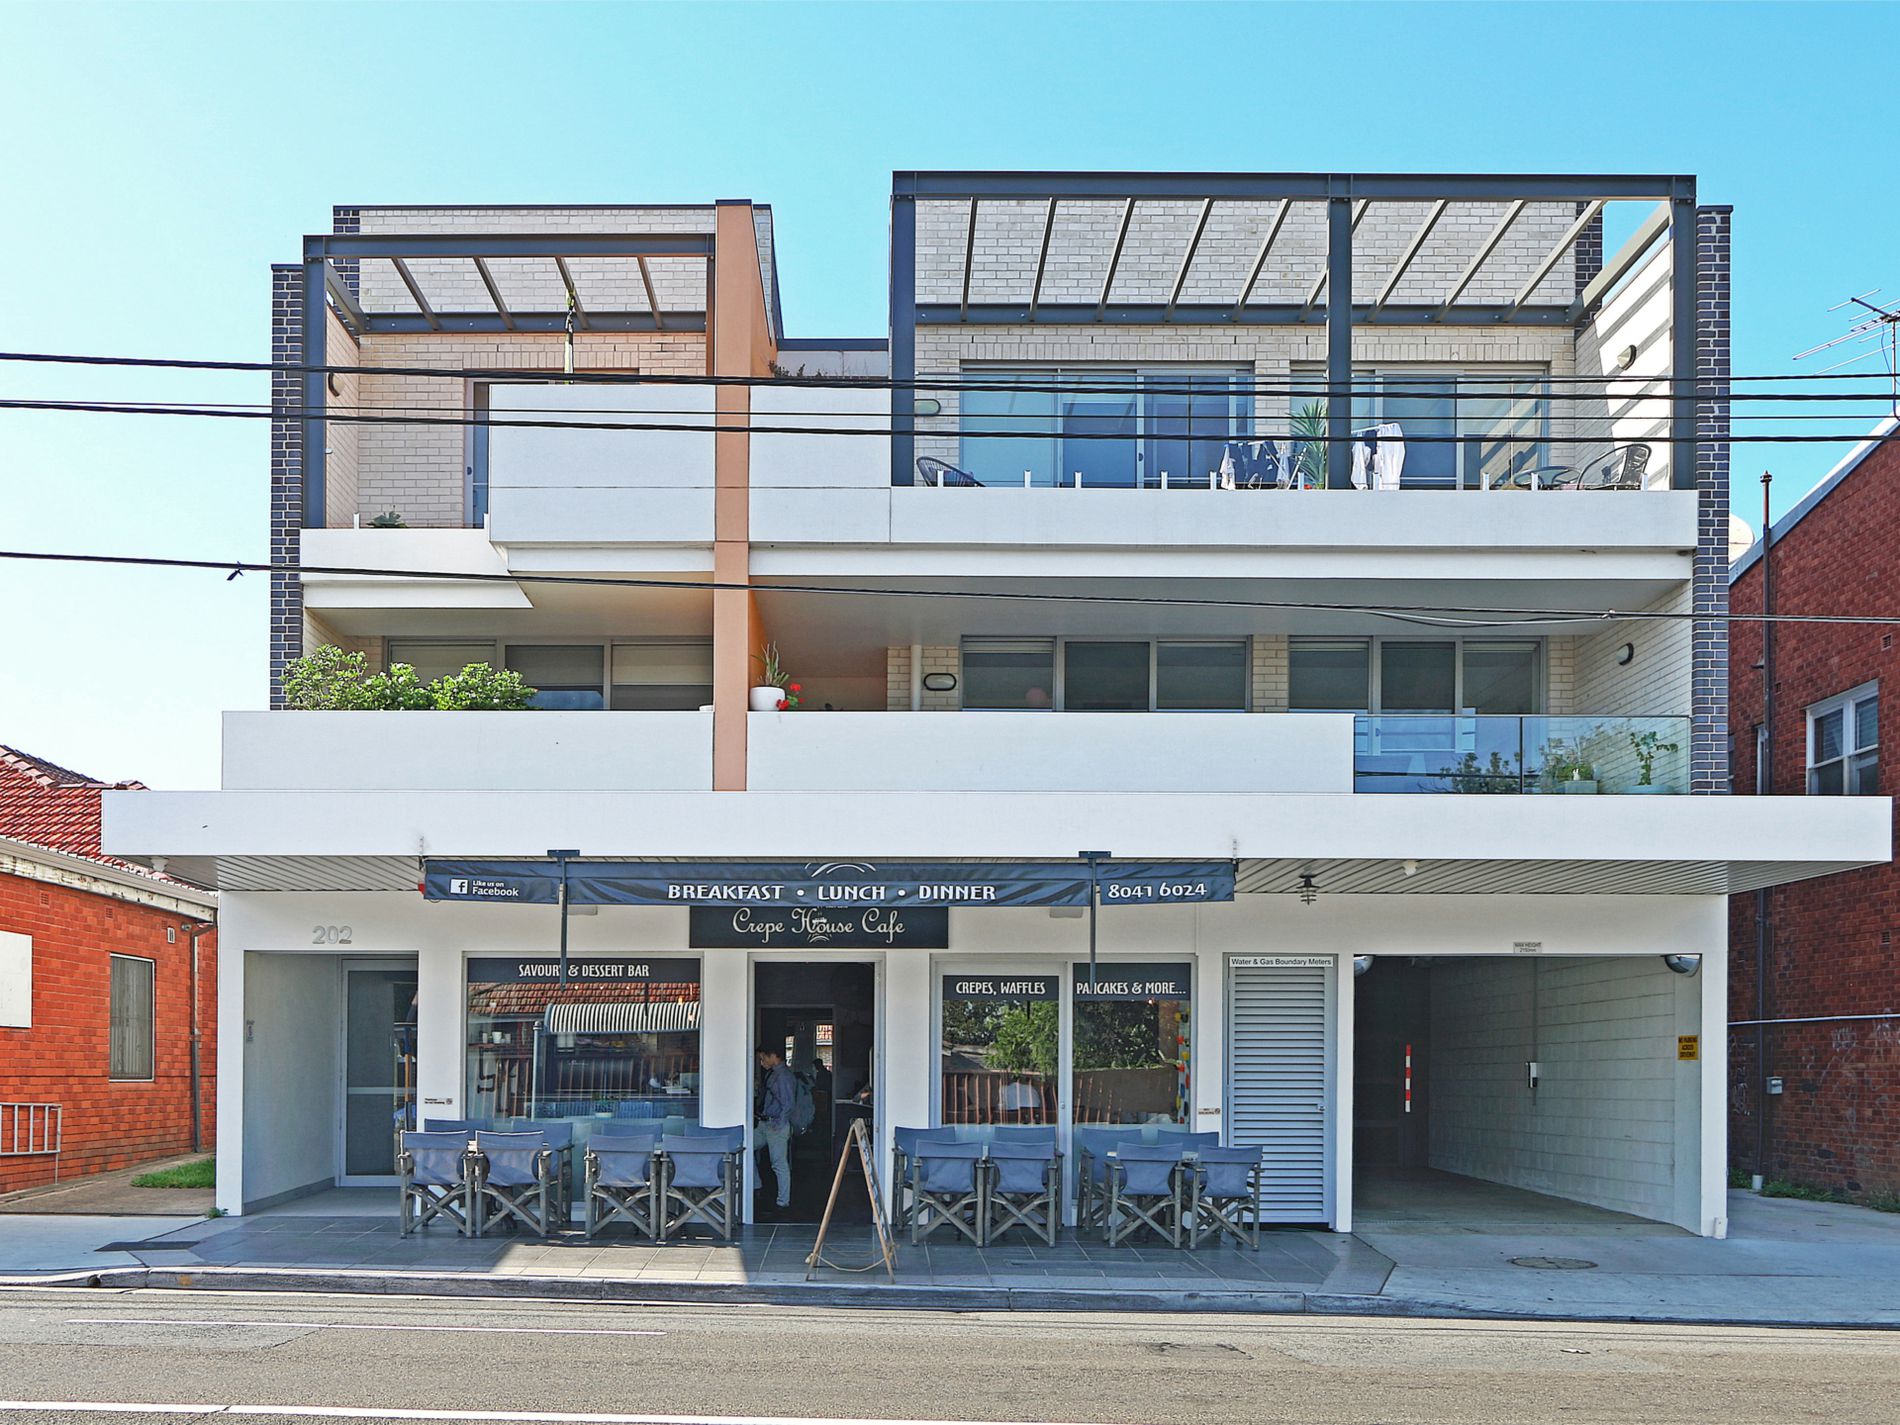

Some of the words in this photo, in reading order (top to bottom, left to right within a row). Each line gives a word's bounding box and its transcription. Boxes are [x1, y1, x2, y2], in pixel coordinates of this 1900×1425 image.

[472, 886, 519, 897] Facebook
[668, 884, 785, 900] BREAKFAST
[817, 885, 886, 900] LUNCH
[919, 885, 996, 900] DINNER
[1159, 882, 1207, 897] 6024
[732, 907, 785, 943] Crepe
[791, 908, 854, 934] House
[861, 907, 906, 943] Cafe
[312, 925, 352, 945] 202
[1275, 958, 1307, 966] Boundary
[519, 964, 562, 977] SAVOUR
[568, 964, 579, 977] &
[582, 964, 625, 977] DESSERT
[627, 964, 650, 977] BAR
[955, 981, 997, 996] CREPES,
[1000, 981, 1046, 994] WAFFLES
[1131, 982, 1143, 994] &
[1145, 982, 1187, 994] MORE...
